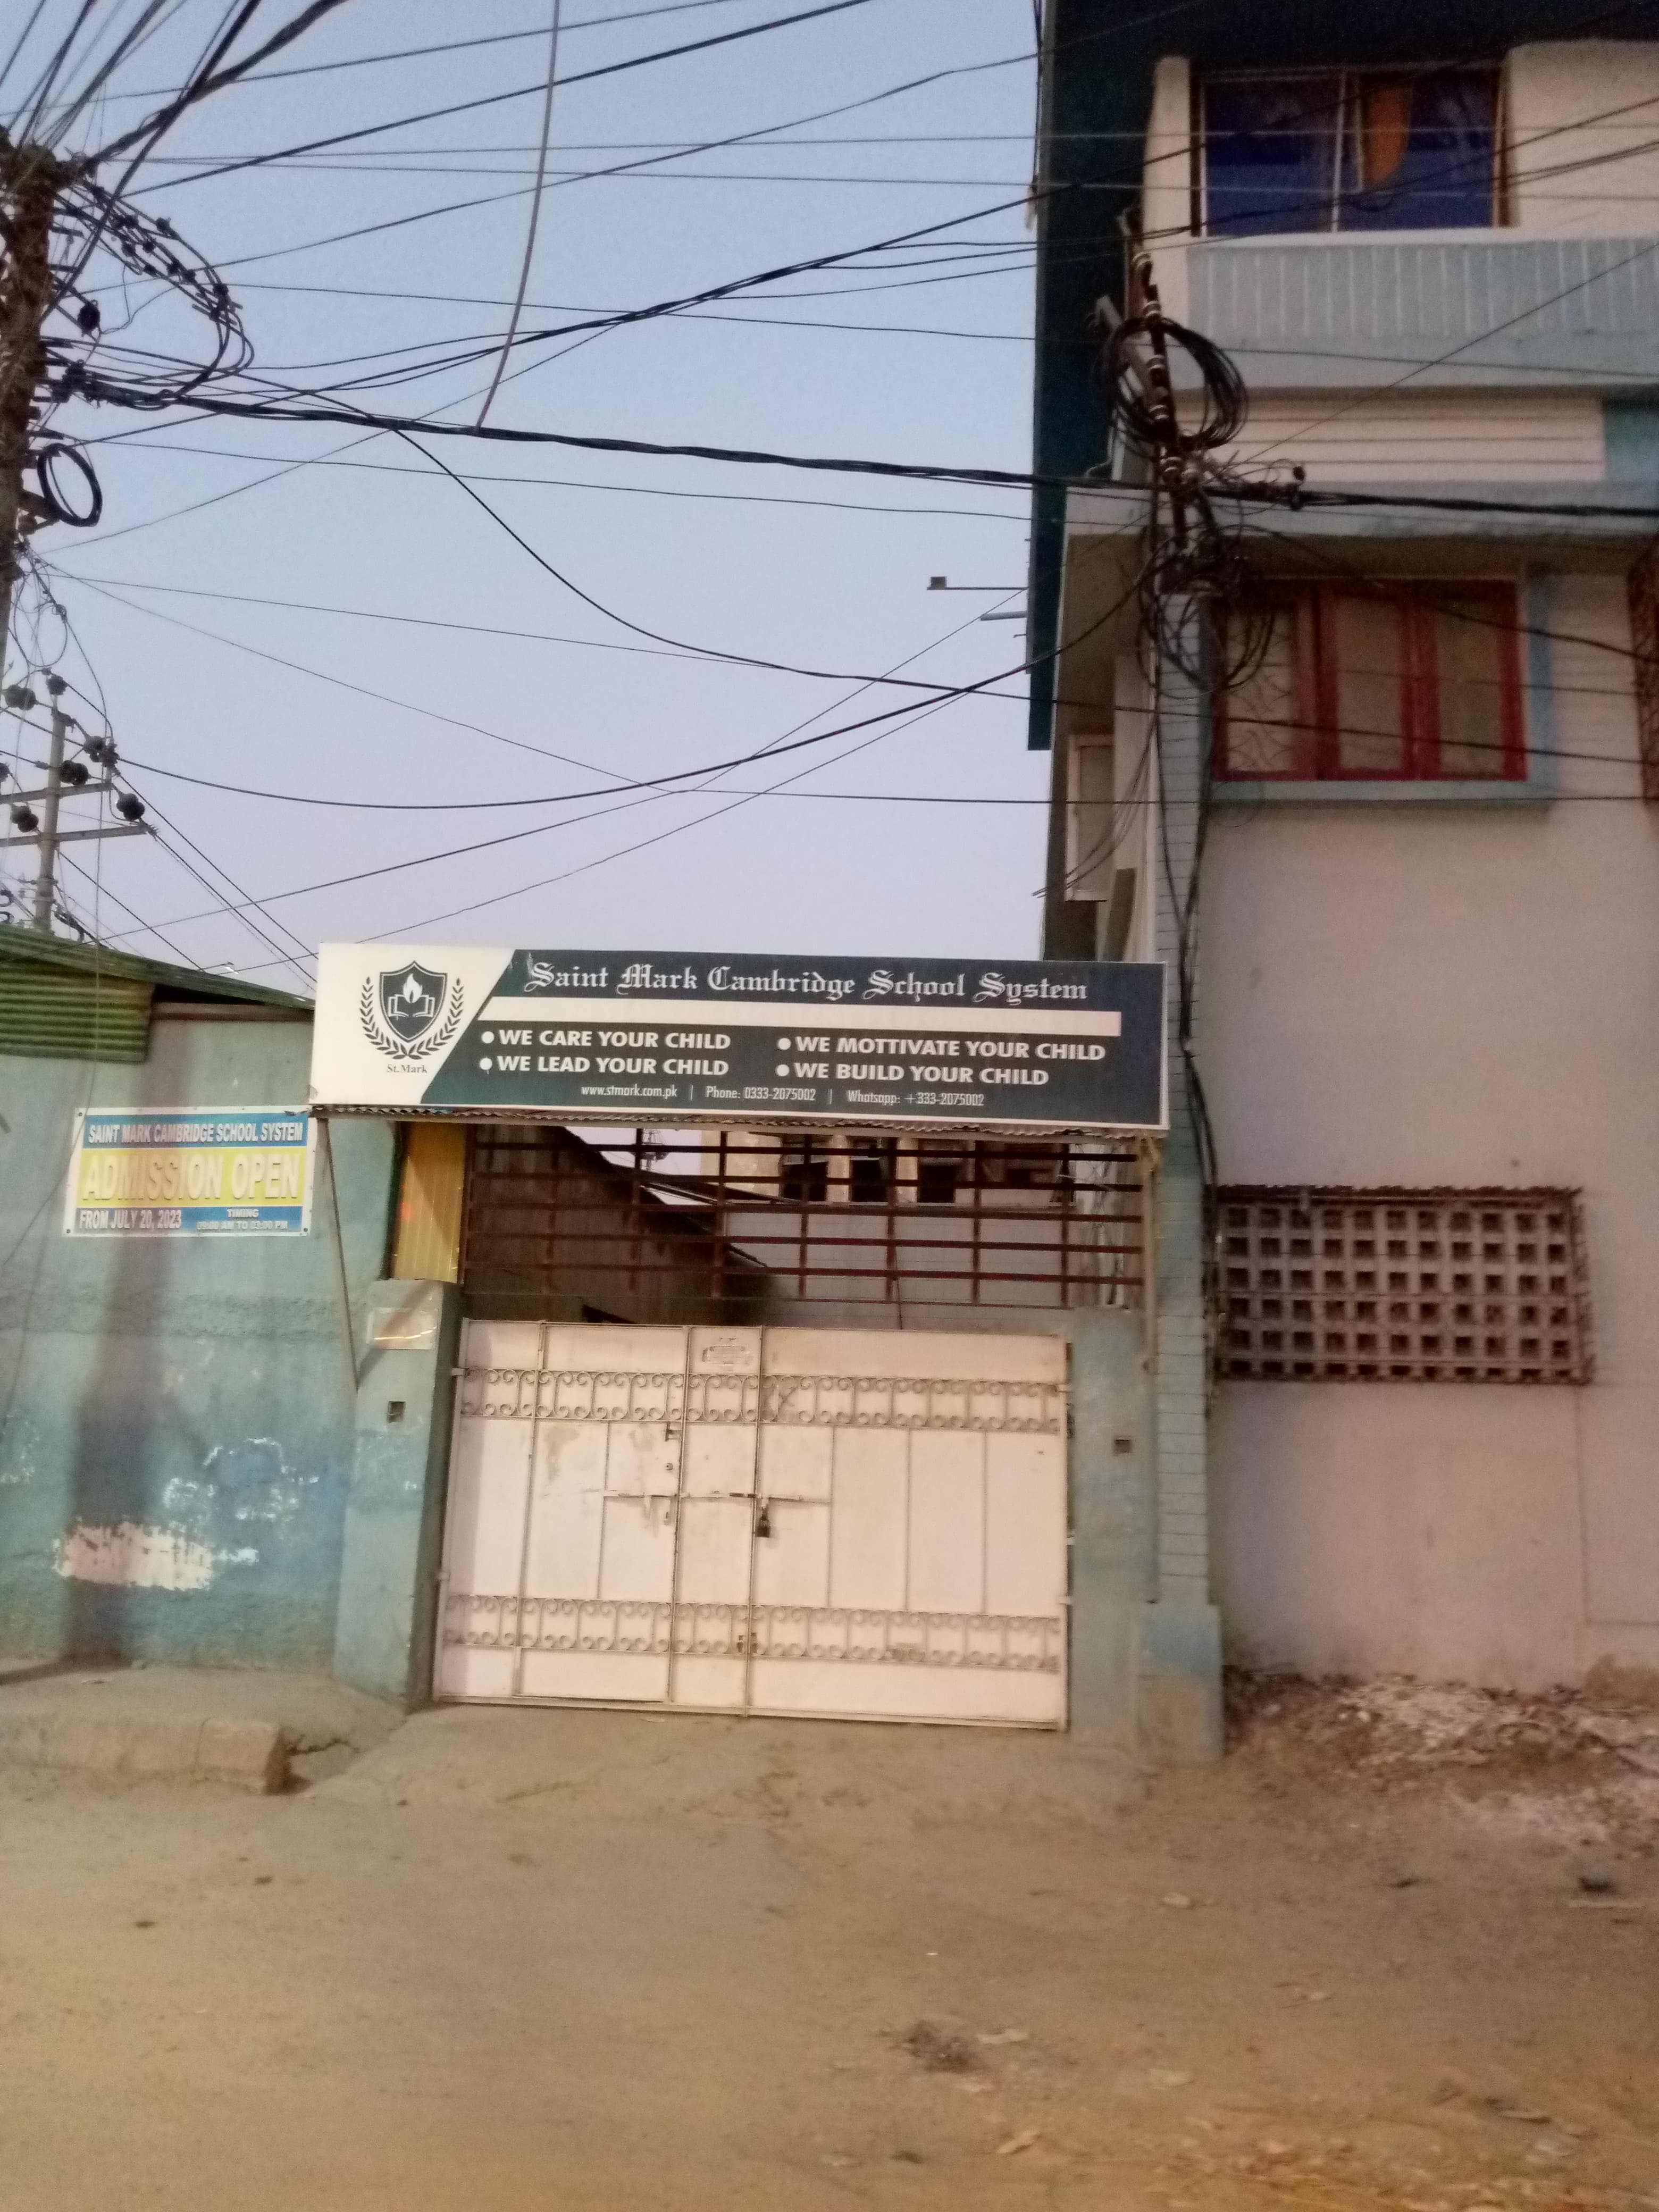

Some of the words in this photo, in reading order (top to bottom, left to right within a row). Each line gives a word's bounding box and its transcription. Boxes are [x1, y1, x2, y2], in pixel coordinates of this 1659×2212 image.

[524, 961, 609, 992] Saint
[616, 963, 698, 995] Mark
[707, 965, 856, 1001] Cambridge
[861, 970, 965, 1002] School
[973, 971, 1088, 1006] System
[499, 1029, 532, 1045] WE
[539, 1030, 592, 1046] CARE
[598, 1031, 659, 1048] YOUR
[665, 1033, 731, 1049] CHILD
[795, 1036, 831, 1053] WE
[836, 1038, 960, 1056] MOTTIVATE
[965, 1041, 1030, 1059] YOUR
[1036, 1043, 1106, 1060] CHILD
[497, 1055, 531, 1071] WE
[538, 1057, 590, 1073] LEAD
[596, 1057, 657, 1074] YOUR
[663, 1059, 729, 1076] CHILD
[794, 1062, 828, 1079] WE
[836, 1064, 904, 1082] BUILD
[910, 1066, 974, 1083] YOUR
[979, 1068, 1049, 1085] CHILD
[581, 1084, 678, 1100] www.stmark.com.pk
[705, 1085, 741, 1099] Phone:
[744, 1087, 816, 1101] 0333-2075002
[847, 1090, 900, 1106] Whatsapp:
[89, 1125, 120, 1143] SAINT
[121, 1125, 151, 1143] MARK
[154, 1124, 214, 1143] CAMBRIDGE
[216, 1123, 258, 1142] SCHOOL
[260, 1122, 303, 1141] SYSTEM
[82, 1153, 224, 1200] ADMISSION
[231, 1153, 300, 1200] OPEN
[80, 1210, 110, 1229] FROM
[110, 1210, 138, 1229] JULY
[139, 1210, 155, 1231] 20,
[157, 1209, 182, 1229] 2023
[227, 1208, 259, 1218] TIMING
[237, 1220, 248, 1230] TO
